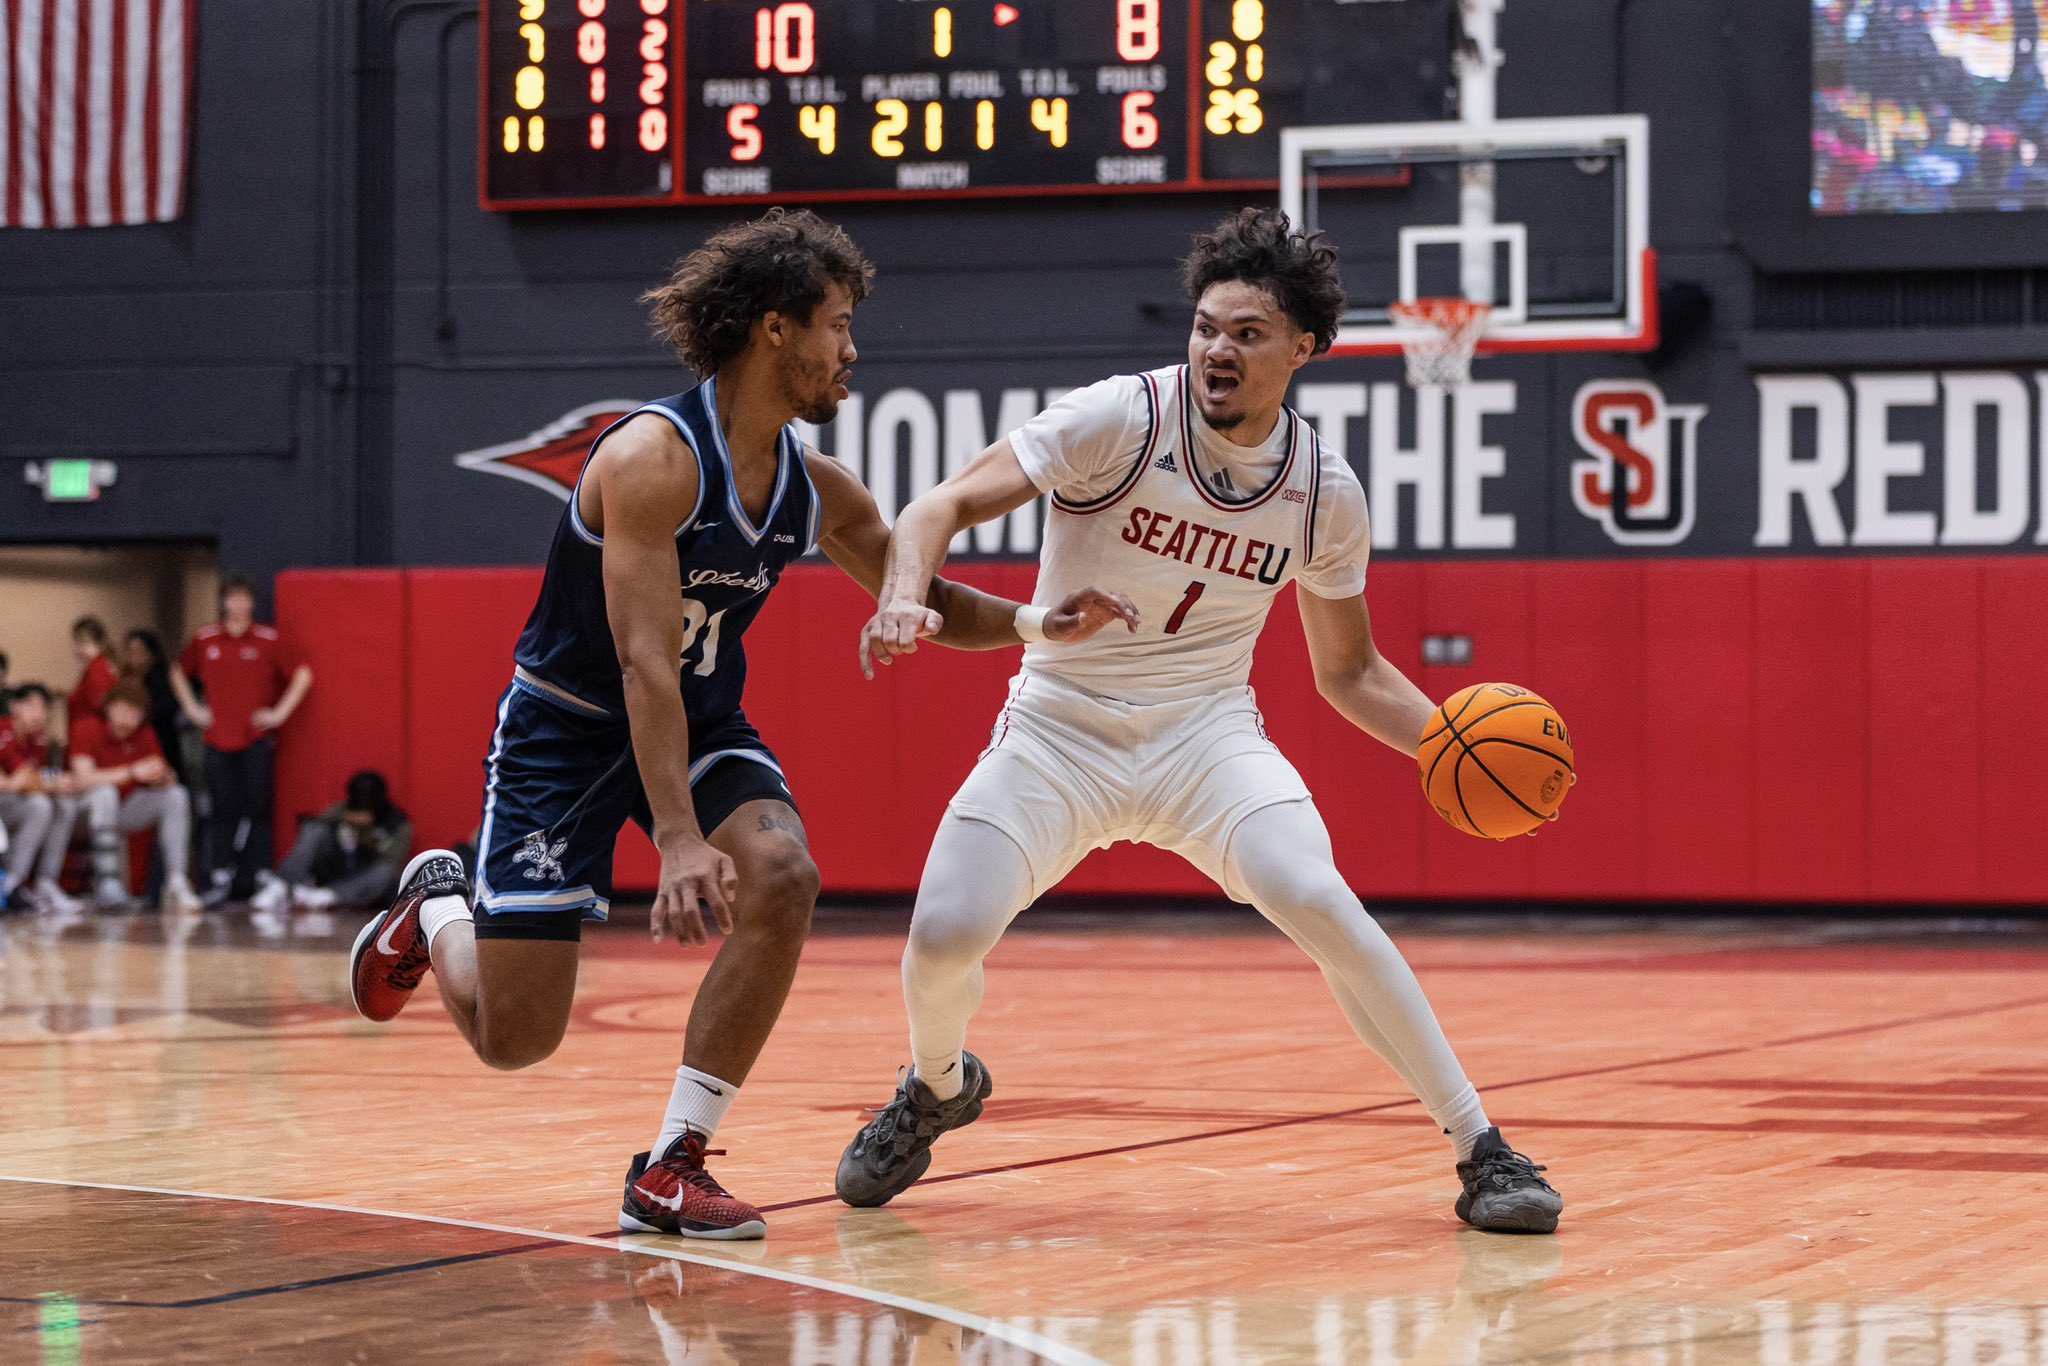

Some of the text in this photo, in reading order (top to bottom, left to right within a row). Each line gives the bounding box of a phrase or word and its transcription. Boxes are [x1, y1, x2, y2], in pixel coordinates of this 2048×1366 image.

[577, 20, 606, 64] 0
[639, 18, 668, 62] 2
[755, 2, 815, 73] 10
[931, 6, 952, 58] 1
[1115, 0, 1161, 61] 8
[590, 66, 607, 104] 1
[639, 61, 668, 105] 2
[1205, 40, 1264, 87] 21
[503, 106, 668, 154] 11 1 0
[726, 103, 763, 161] 5
[799, 104, 836, 155] 4
[871, 98, 943, 157] 21
[1030, 98, 1068, 149] 4
[1121, 91, 1160, 149] 6
[1297, 381, 1517, 550] THE
[1753, 371, 2048, 548] RED
[1163, 580, 1207, 635] 1
